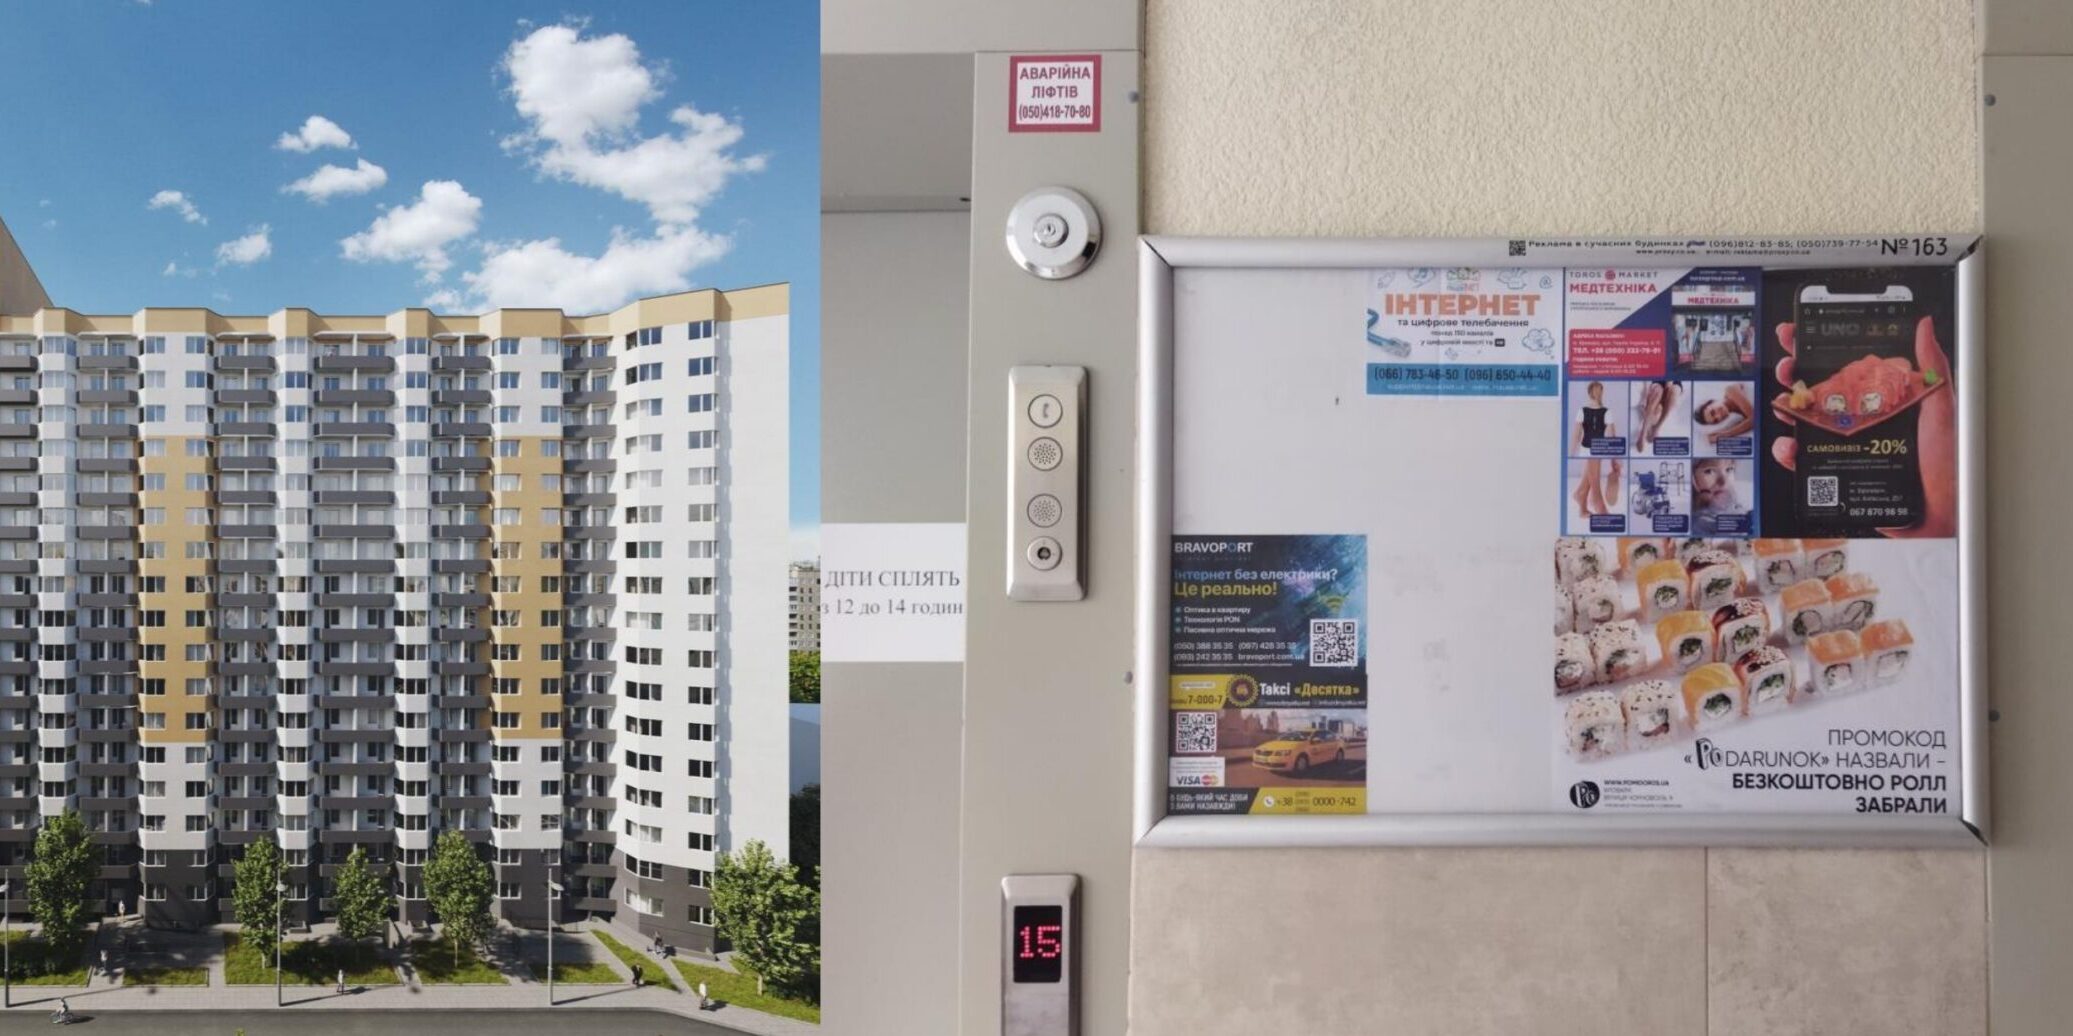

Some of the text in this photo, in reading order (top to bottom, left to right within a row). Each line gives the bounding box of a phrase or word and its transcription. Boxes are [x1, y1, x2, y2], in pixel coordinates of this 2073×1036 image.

[1020, 64, 1091, 79] АВАРІЙНА
[1032, 86, 1078, 98] ЛІФТІВ
[1019, 104, 1091, 120] (050)418-70-80
[1569, 283, 1658, 294] МЕДТЕХНІКА
[1385, 293, 1541, 316] ІНТЕРНЕТ
[1411, 319, 1458, 328] цифрове
[1461, 319, 1529, 327] телебачення
[1807, 439, 1907, 454] САМОВИВІЗ -20%
[1849, 507, 1865, 516] 067
[1175, 542, 1253, 553] BRAVOPORT
[825, 570, 961, 588] ДІТИ СПЛЯТЬ
[1174, 568, 1338, 582] Інтернет без електрики?
[1175, 582, 1278, 598] Це реально!
[837, 599, 853, 614] 12
[859, 602, 880, 615] до
[888, 599, 905, 614] 14
[911, 602, 963, 616] годин
[1829, 729, 1947, 748] ПРОМОКОД
[1836, 753, 1931, 768] НАЗВАЛИ
[1176, 776, 1200, 785] VISA
[1733, 773, 1947, 791] БЕЗКОШТОВНО РОЛЛ
[1855, 798, 1947, 813] ЗАБРАЛИ
[1020, 926, 1060, 957] 15
